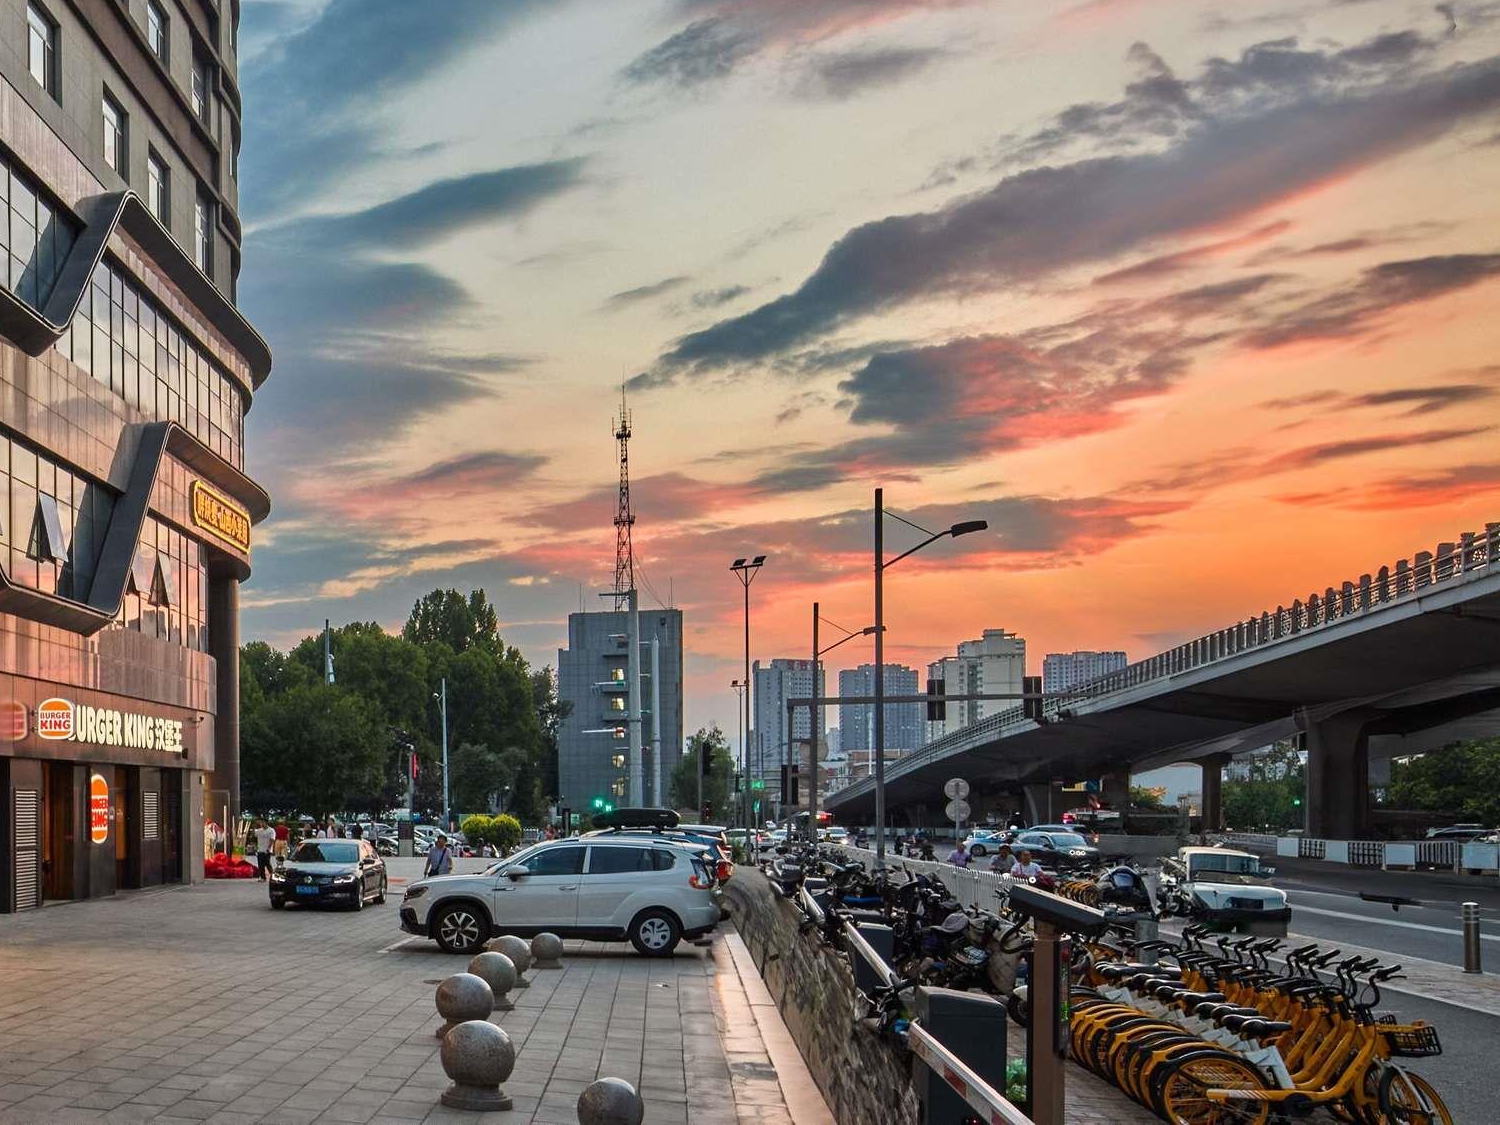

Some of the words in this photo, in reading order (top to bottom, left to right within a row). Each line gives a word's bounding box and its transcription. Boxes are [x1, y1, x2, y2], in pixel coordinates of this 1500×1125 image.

[40, 711, 71, 719] BURGER
[40, 719, 71, 730] KING
[69, 704, 122, 747] URGER
[124, 712, 155, 750] KING
[155, 717, 183, 753] 汉堡王
